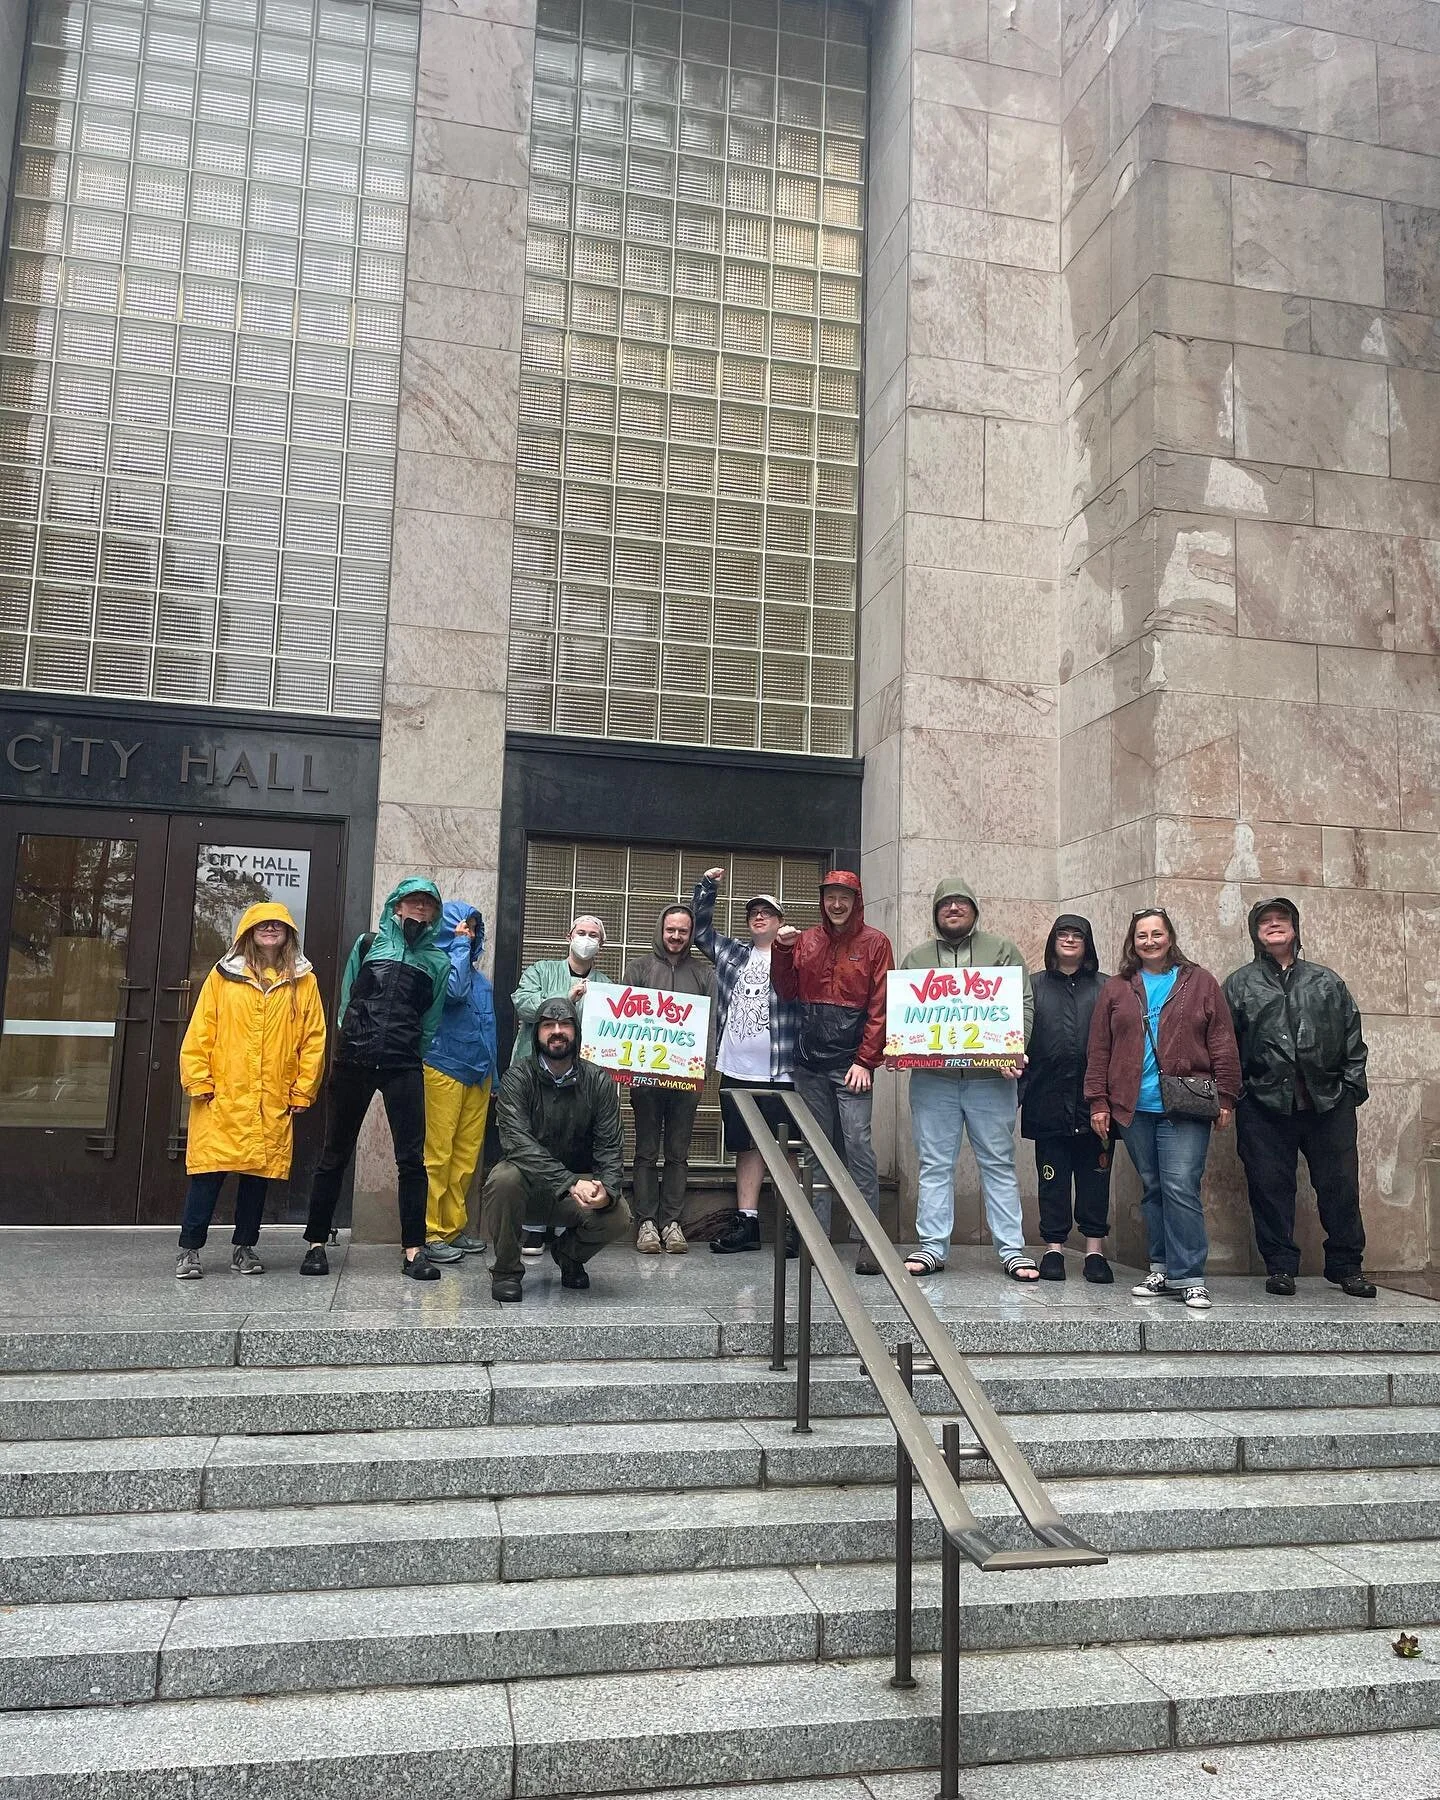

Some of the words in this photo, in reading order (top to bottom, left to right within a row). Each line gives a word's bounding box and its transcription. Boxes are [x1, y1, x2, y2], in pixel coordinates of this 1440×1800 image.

[6, 733, 144, 779] CITY
[179, 745, 330, 794] HALL
[209, 853, 248, 868] CITY
[252, 855, 298, 871] HALL
[909, 969, 961, 1004] VOTE
[962, 968, 1003, 1001] YES!
[606, 986, 654, 1019] VOTE
[656, 991, 693, 1027] YES!
[903, 1005, 1010, 1024] INITIATIVES
[597, 1020, 696, 1048] INITIATIVES
[927, 1023, 944, 1050] 1
[962, 1022, 985, 1050] 2
[617, 1040, 633, 1067] 1
[650, 1043, 671, 1070] 2
[897, 1058, 944, 1068] COMMUNITY
[944, 1058, 973, 1067] FIRST
[973, 1058, 1017, 1067] WHATCOM
[632, 1075, 658, 1086] FIRST
[658, 1078, 697, 1091] WHATCOM
